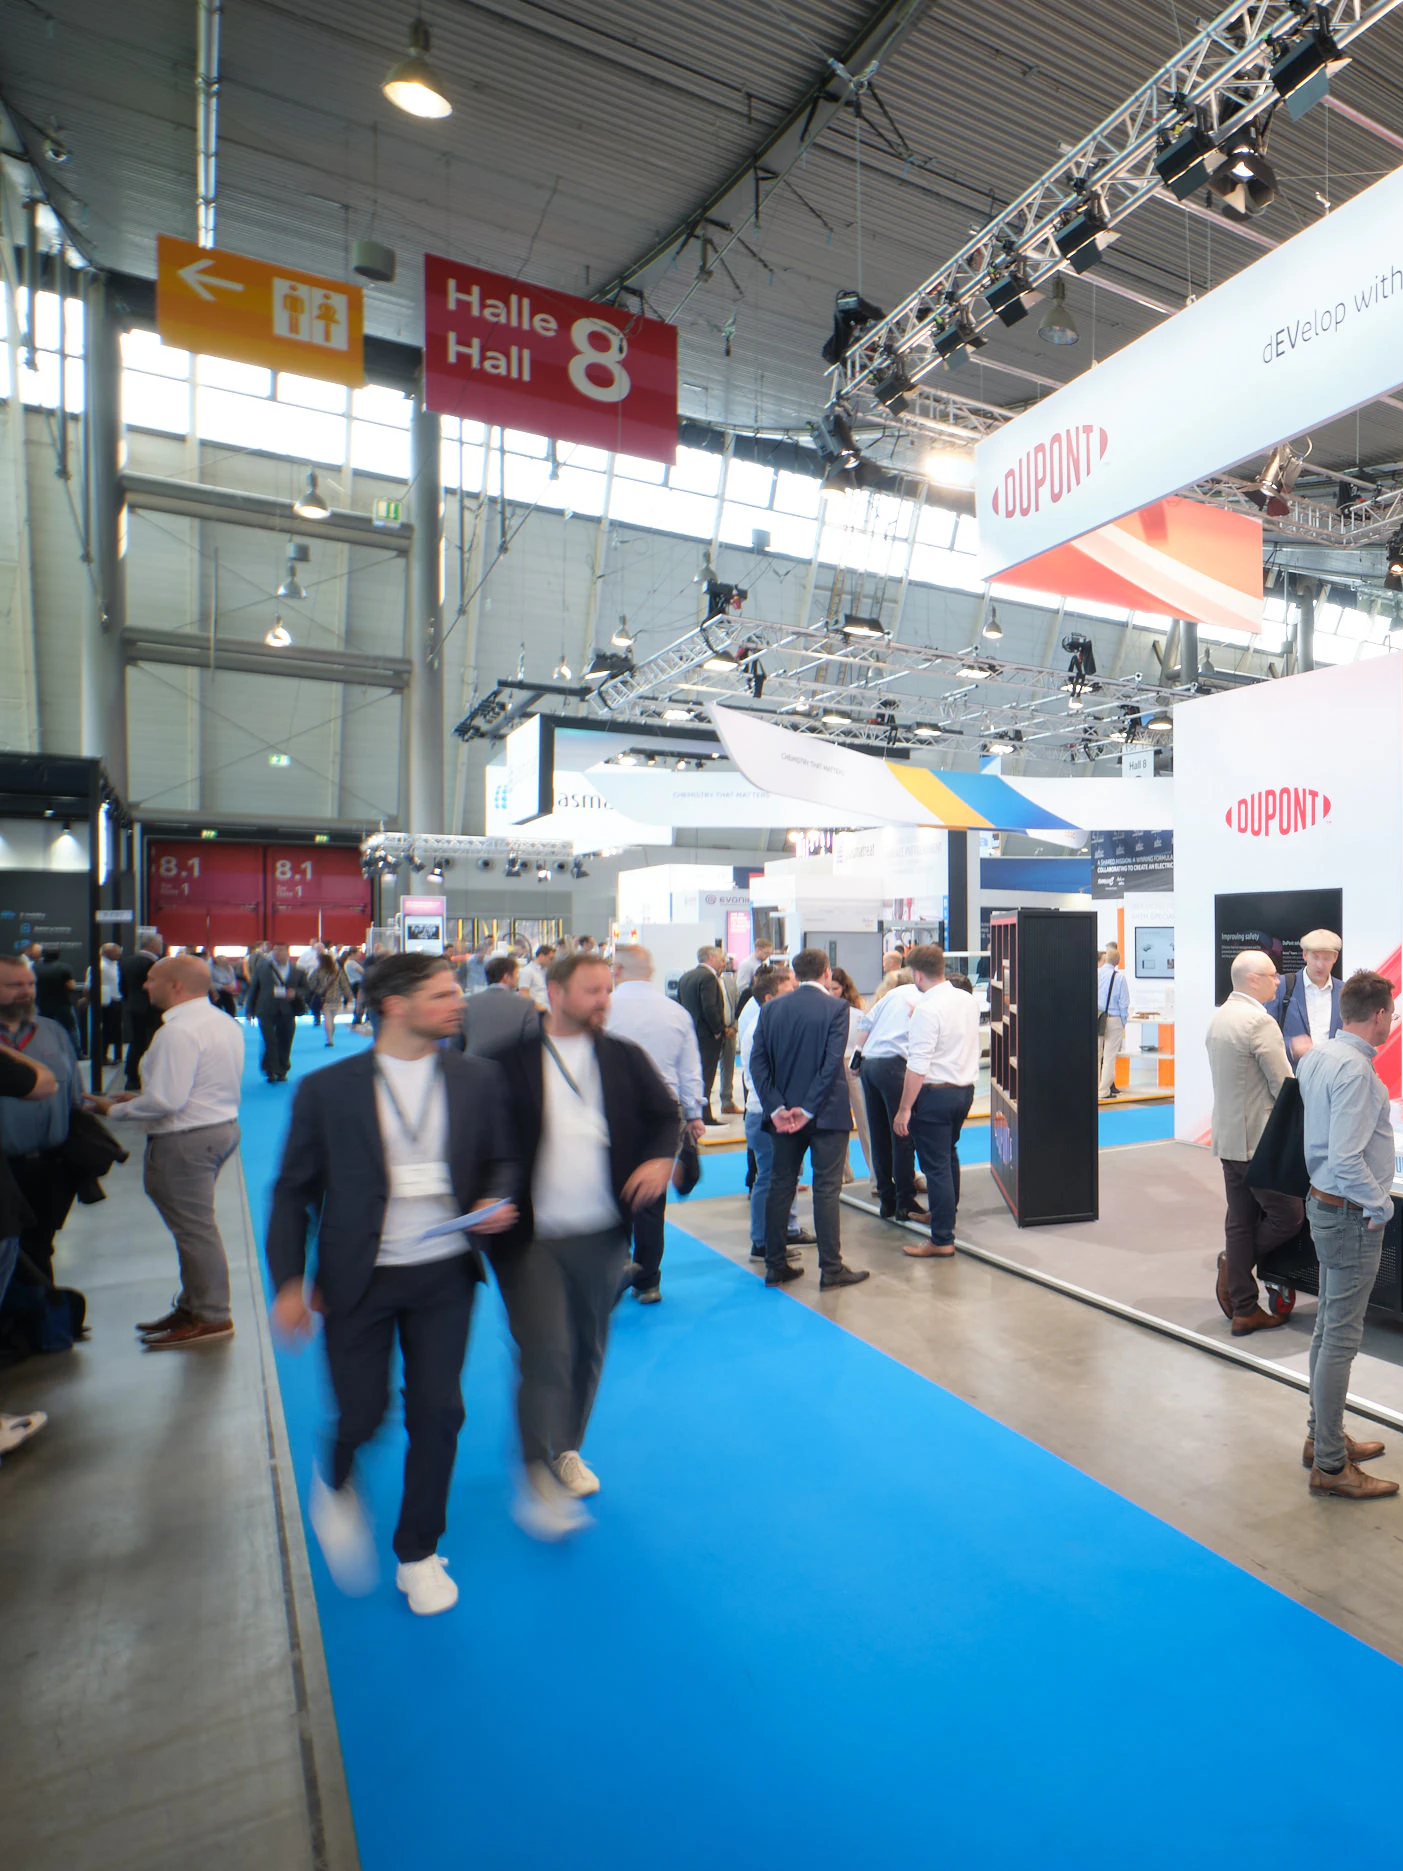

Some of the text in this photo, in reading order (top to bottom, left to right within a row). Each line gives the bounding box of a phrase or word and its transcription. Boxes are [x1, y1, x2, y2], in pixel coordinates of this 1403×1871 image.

[447, 278, 558, 338] Halle
[1263, 303, 1346, 363] dEVelop
[1354, 266, 1403, 312] with
[447, 331, 531, 382] Hall
[568, 317, 631, 403] 8
[1005, 424, 1094, 519] DUPONT
[1129, 760, 1147, 770] Hall 8
[1237, 787, 1319, 837] DUPONT
[159, 856, 200, 878] 8.1
[275, 859, 312, 881] 8.1
[181, 883, 190, 896] 1
[295, 885, 302, 897] 1
[1221, 933, 1260, 941] Improving safety
